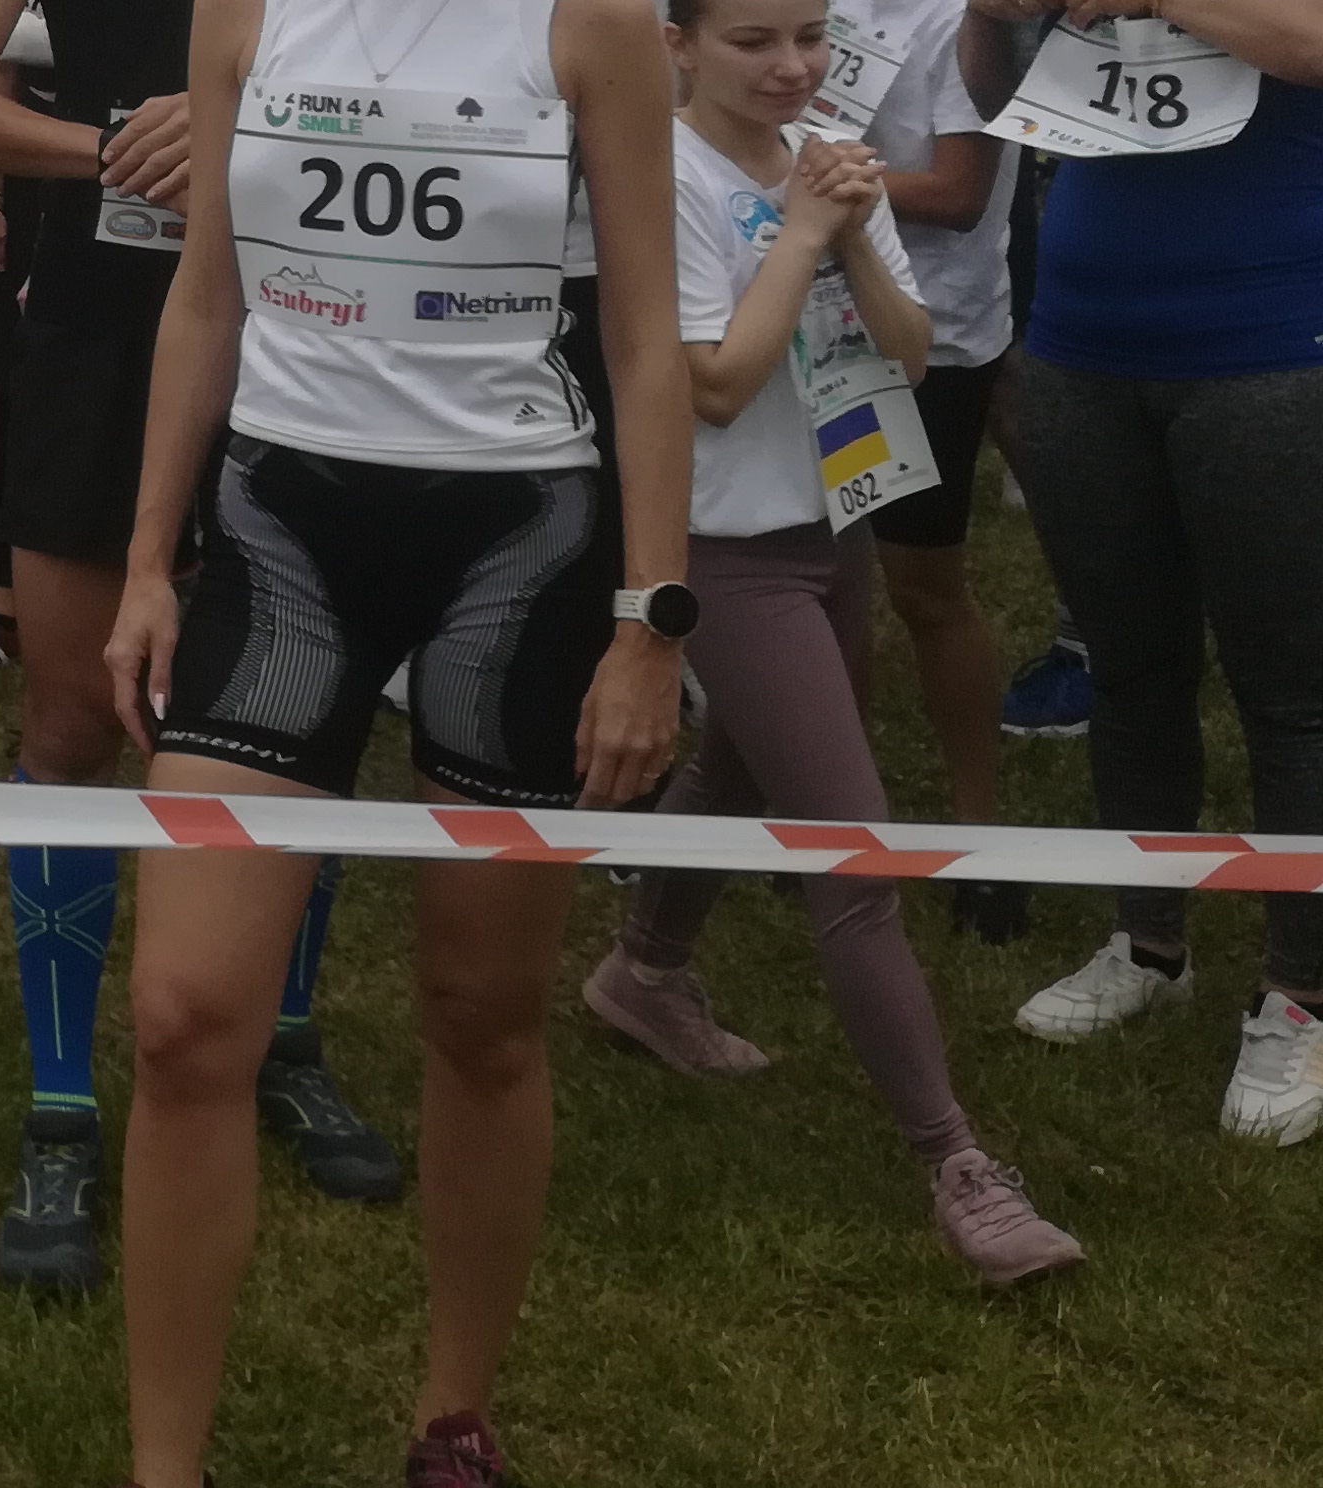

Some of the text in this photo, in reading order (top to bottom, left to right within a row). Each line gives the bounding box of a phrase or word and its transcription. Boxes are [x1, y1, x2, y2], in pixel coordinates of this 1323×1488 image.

[298, 93, 385, 118] RUN 4 A
[297, 114, 363, 136] SMILE
[299, 157, 464, 242] 206
[444, 290, 553, 315] Netrium
[838, 472, 883, 516] 082
